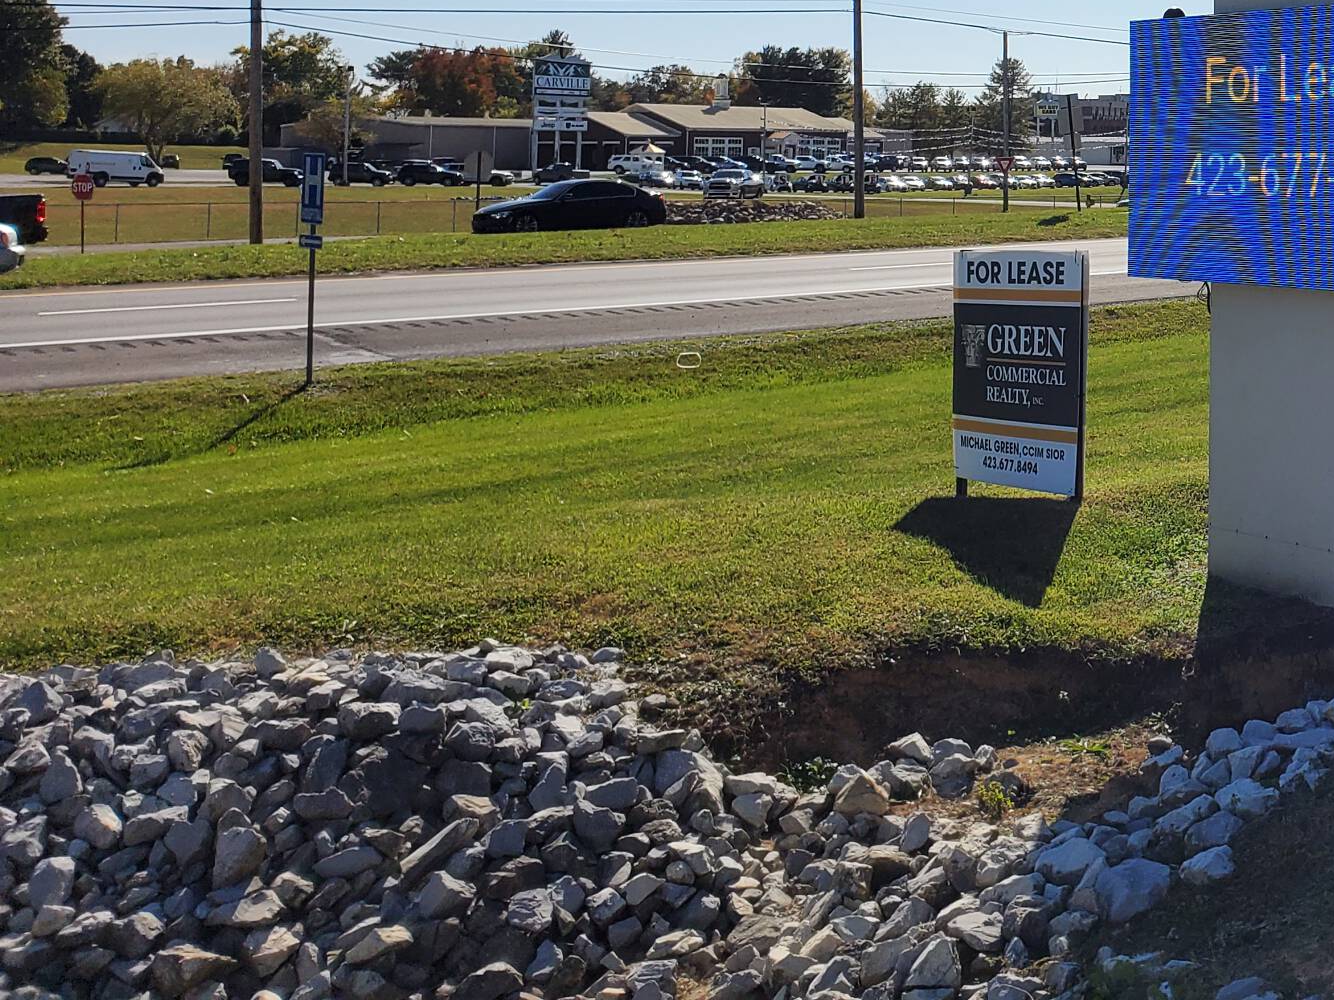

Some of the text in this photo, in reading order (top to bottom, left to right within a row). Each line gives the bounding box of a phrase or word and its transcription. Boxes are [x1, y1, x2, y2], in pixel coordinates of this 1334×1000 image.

[536, 76, 588, 89] CARVILLE
[1204, 56, 1268, 104] For
[73, 182, 93, 193] STOP
[966, 260, 1065, 285] FOR LEASE
[987, 323, 1067, 358] GREEN
[986, 364, 1067, 386] COMMERCIAL
[986, 385, 1031, 408] REALTY,
[960, 435, 992, 451] MICHAEL
[1045, 448, 1065, 461] SIOR
[982, 455, 1038, 476] 423.677.8494
